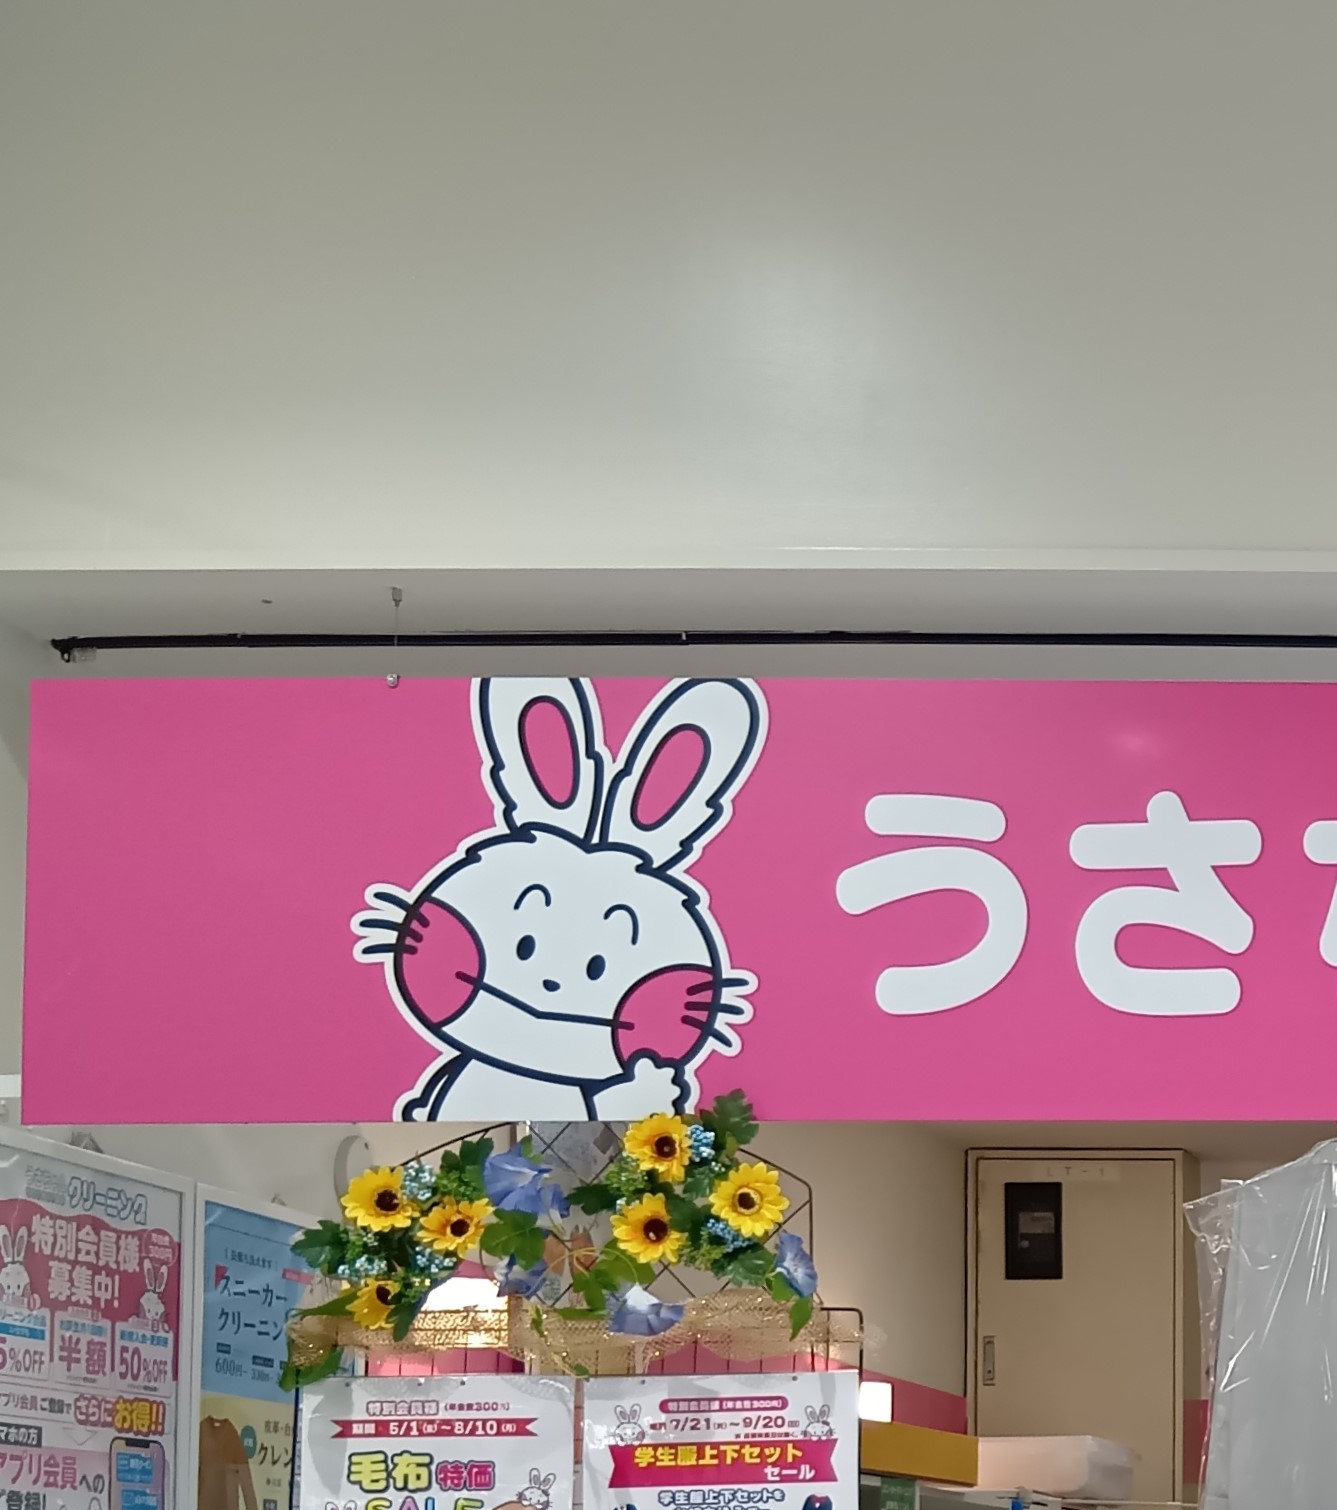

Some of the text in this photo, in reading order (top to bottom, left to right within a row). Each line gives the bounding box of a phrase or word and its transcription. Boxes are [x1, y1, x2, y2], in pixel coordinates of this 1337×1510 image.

[68, 1176, 148, 1226] クリーニング
[31, 1213, 141, 1273] 特別会員様
[48, 1260, 120, 1309] 募集中!
[219, 1274, 288, 1308] スニーカー
[59, 1334, 108, 1377] 半額
[119, 1345, 168, 1385] 50%OFF
[113, 1398, 165, 1437] お得!!
[366, 1400, 439, 1417] 特別会員様
[348, 1450, 496, 1493] 毛布 特価
[634, 1444, 803, 1467] 学生服上下セット
[764, 1465, 815, 1481] セール
[658, 1489, 785, 1505] 学生服上下セットを
